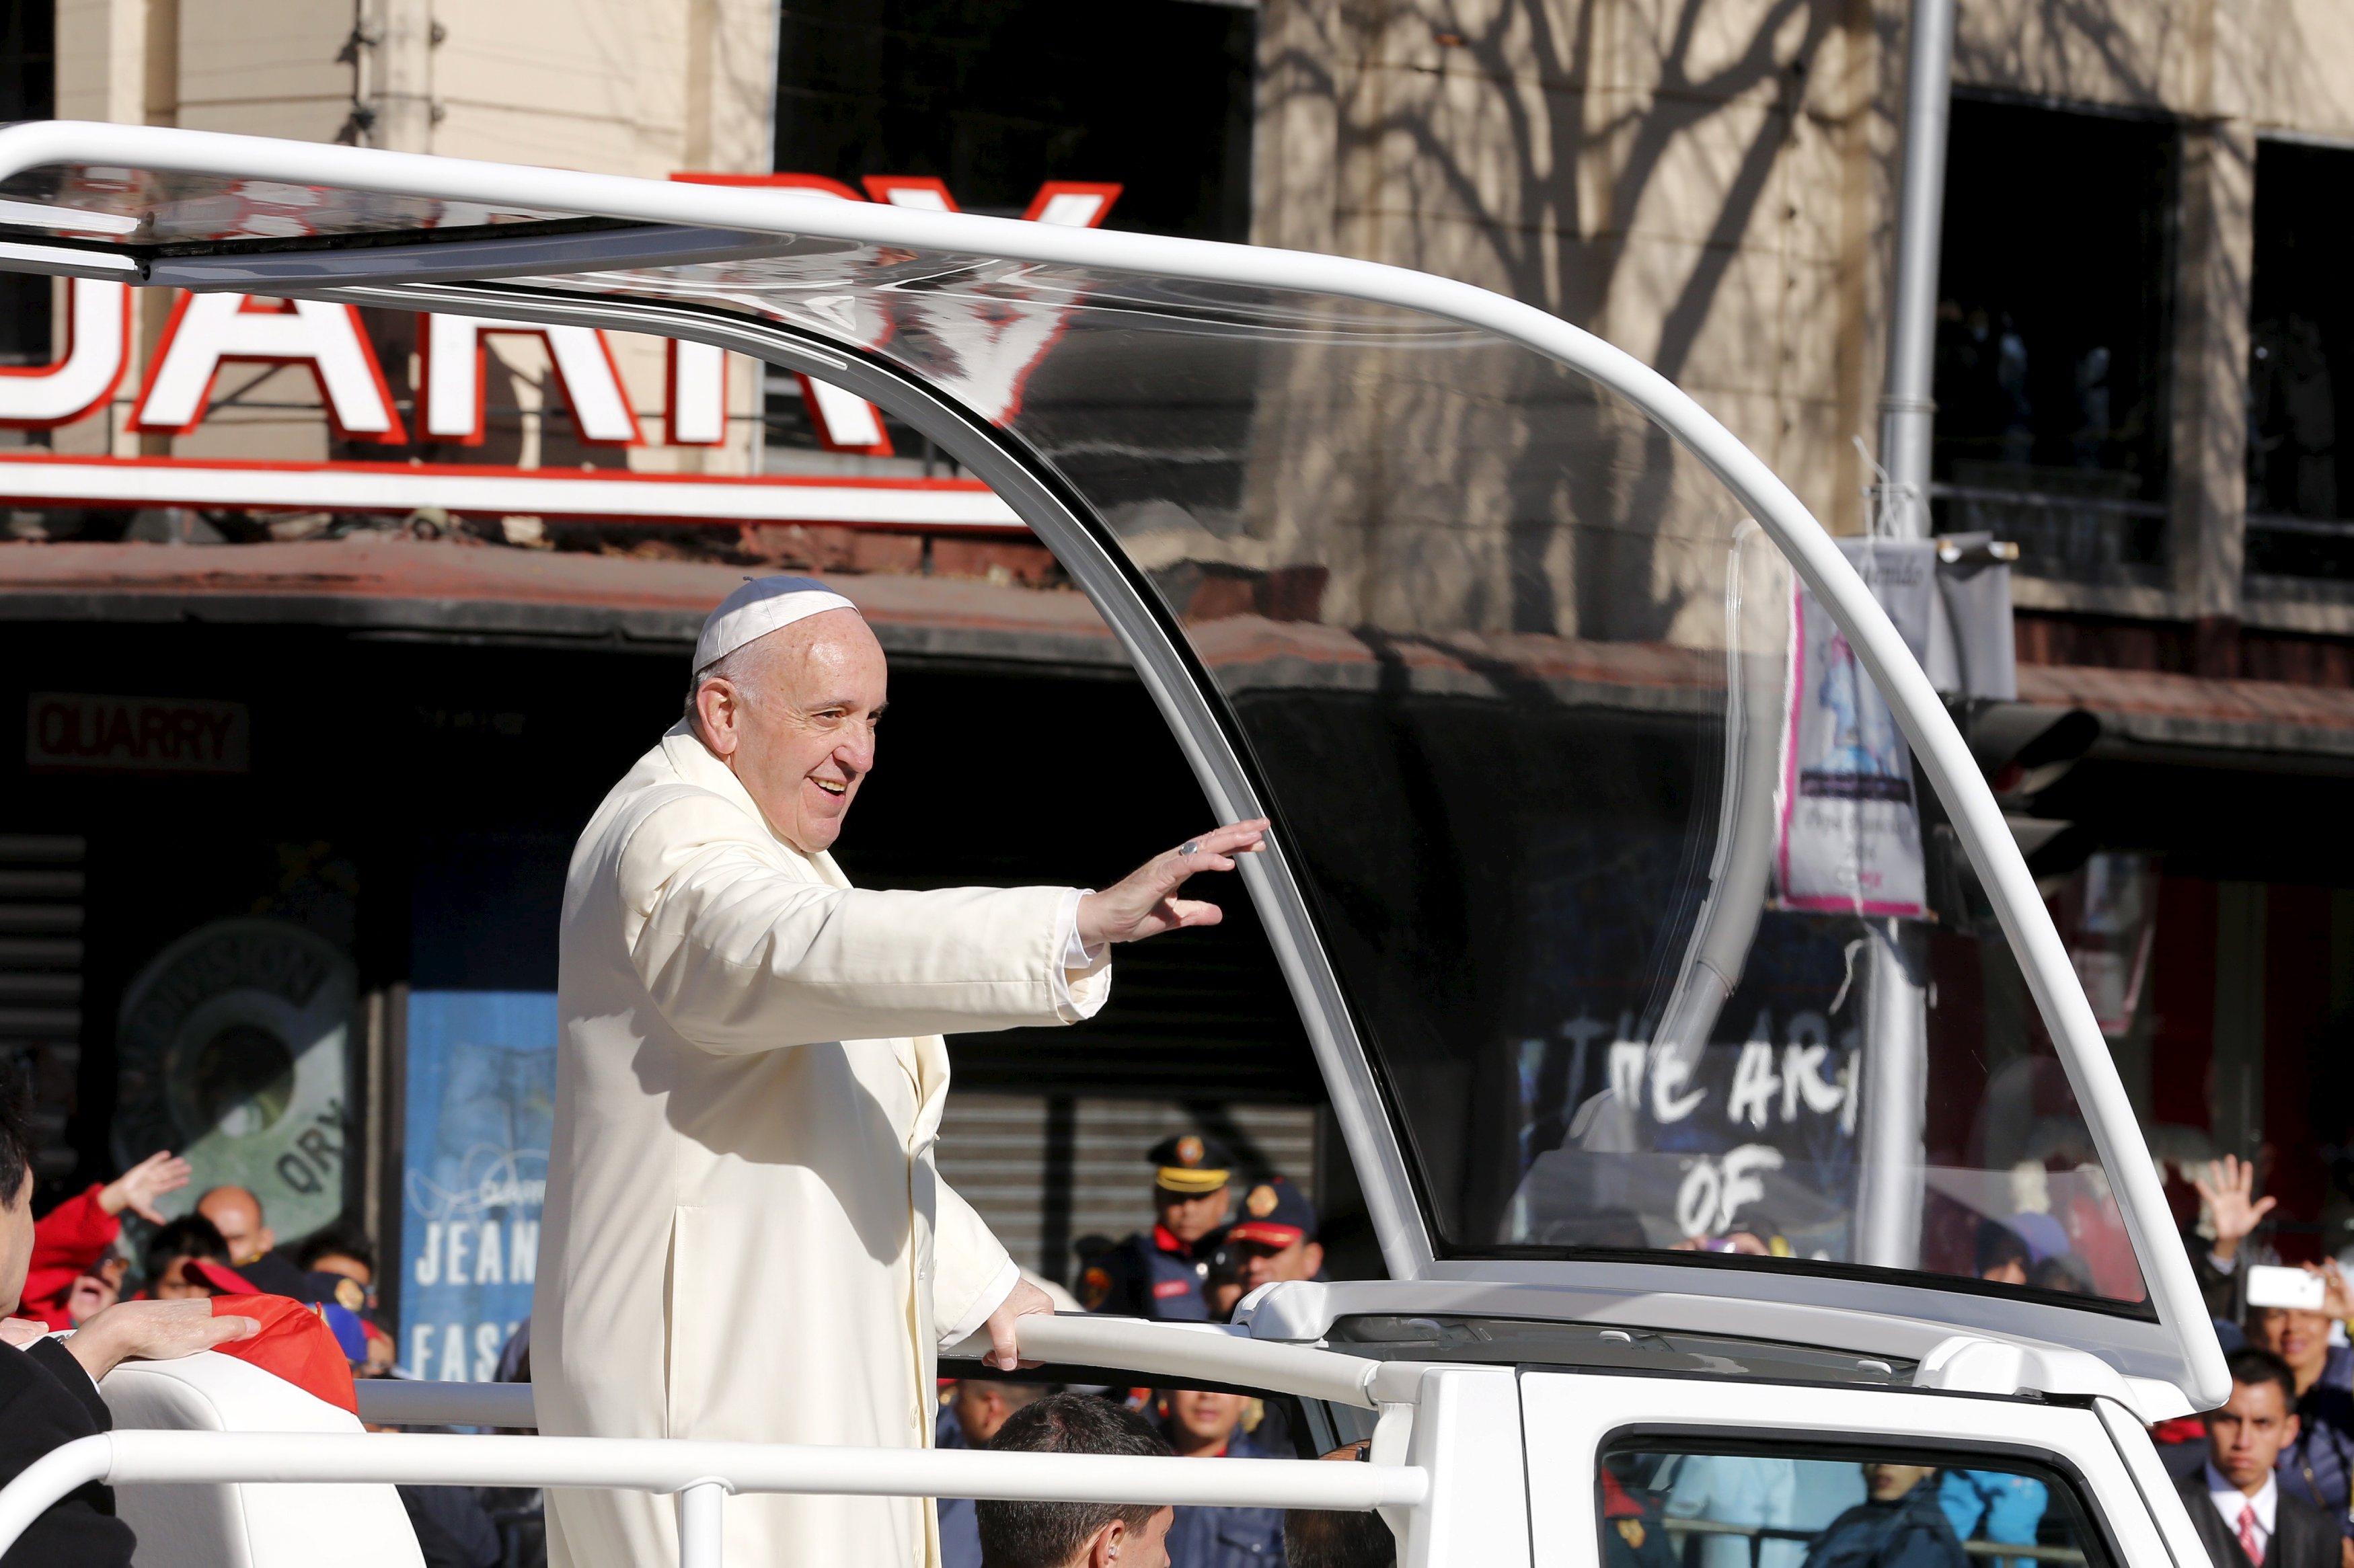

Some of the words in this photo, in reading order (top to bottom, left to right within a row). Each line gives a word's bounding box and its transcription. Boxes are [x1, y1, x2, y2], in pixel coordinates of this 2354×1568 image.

[39, 702, 234, 760] QUARRY
[1677, 1142, 1785, 1237] OF
[411, 1322, 521, 1382] FAS
